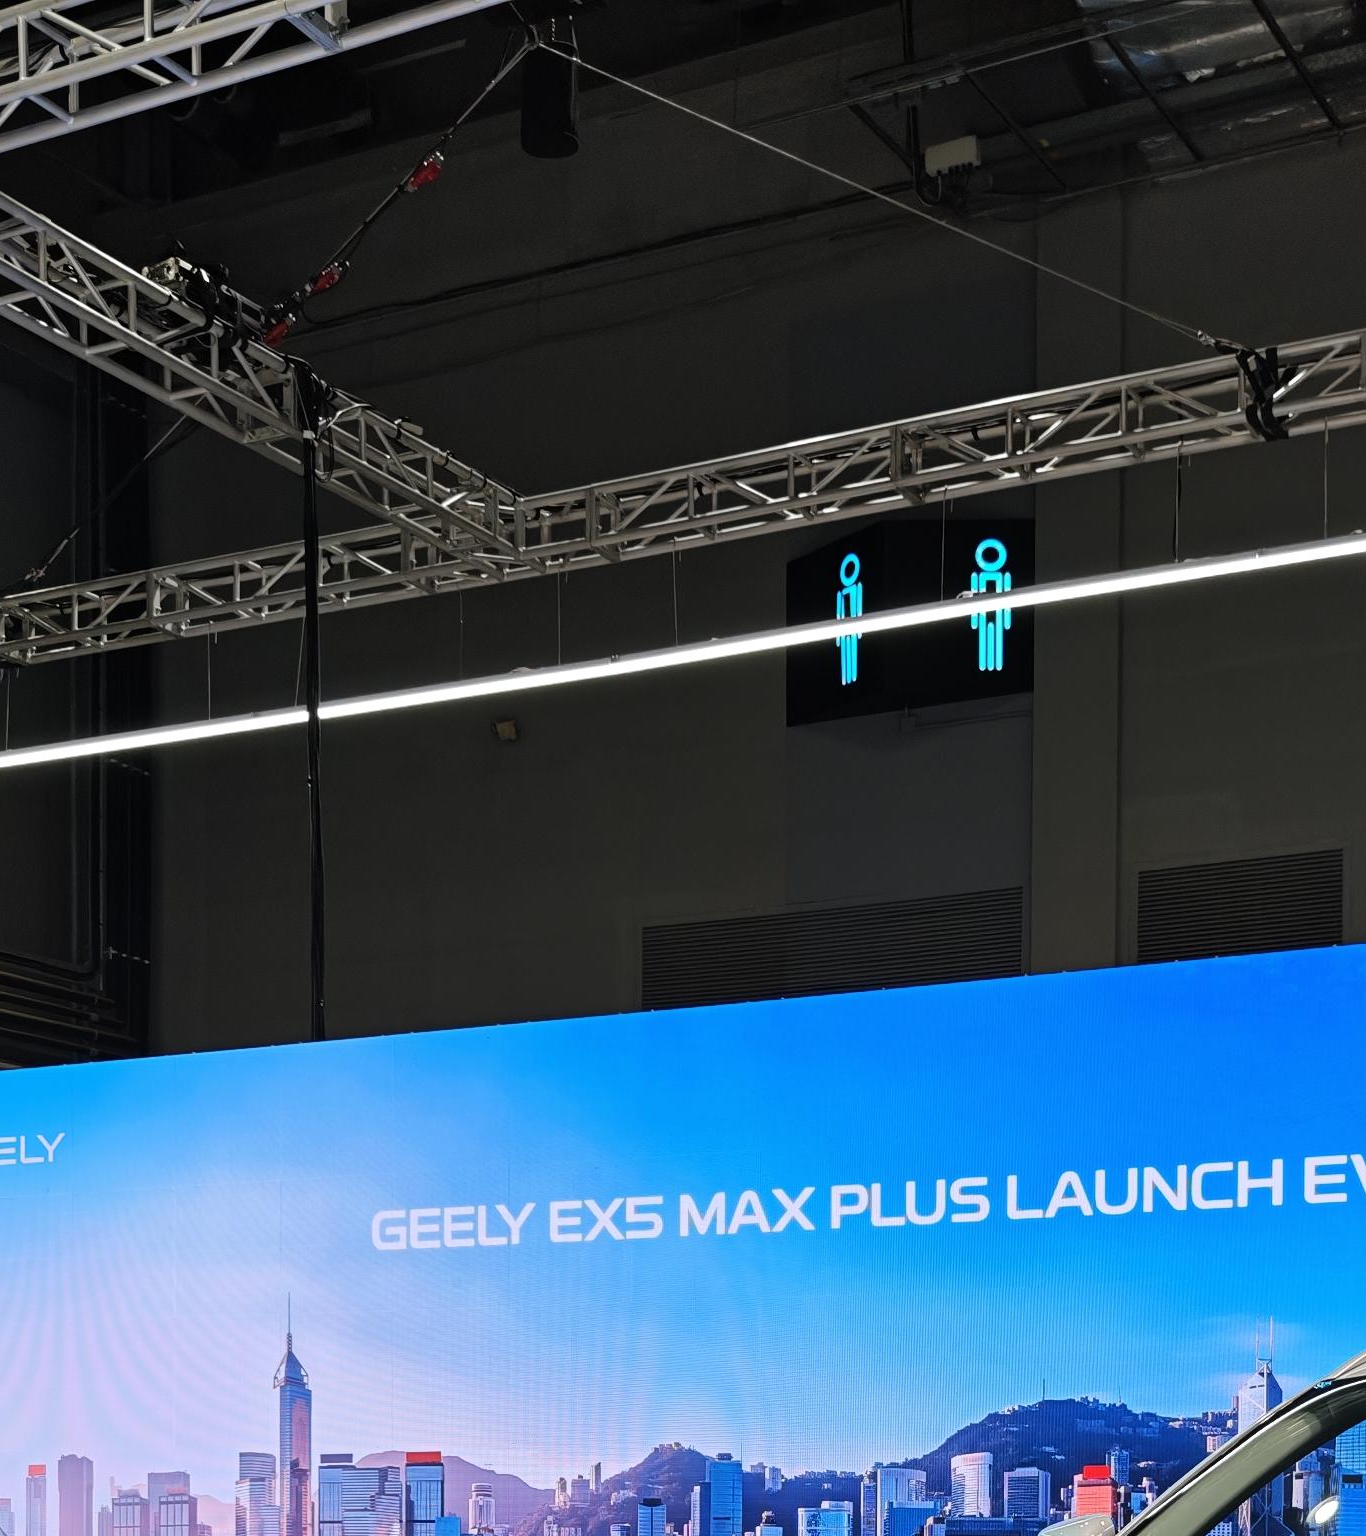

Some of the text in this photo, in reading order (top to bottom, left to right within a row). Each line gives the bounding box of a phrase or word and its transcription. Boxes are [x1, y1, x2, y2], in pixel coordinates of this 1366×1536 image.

[371, 1202, 536, 1251] GEELY
[549, 1196, 664, 1243] EX5
[679, 1186, 816, 1237] MAX
[830, 1176, 990, 1230] PLUS
[1006, 1158, 1284, 1220] LAUNCH
